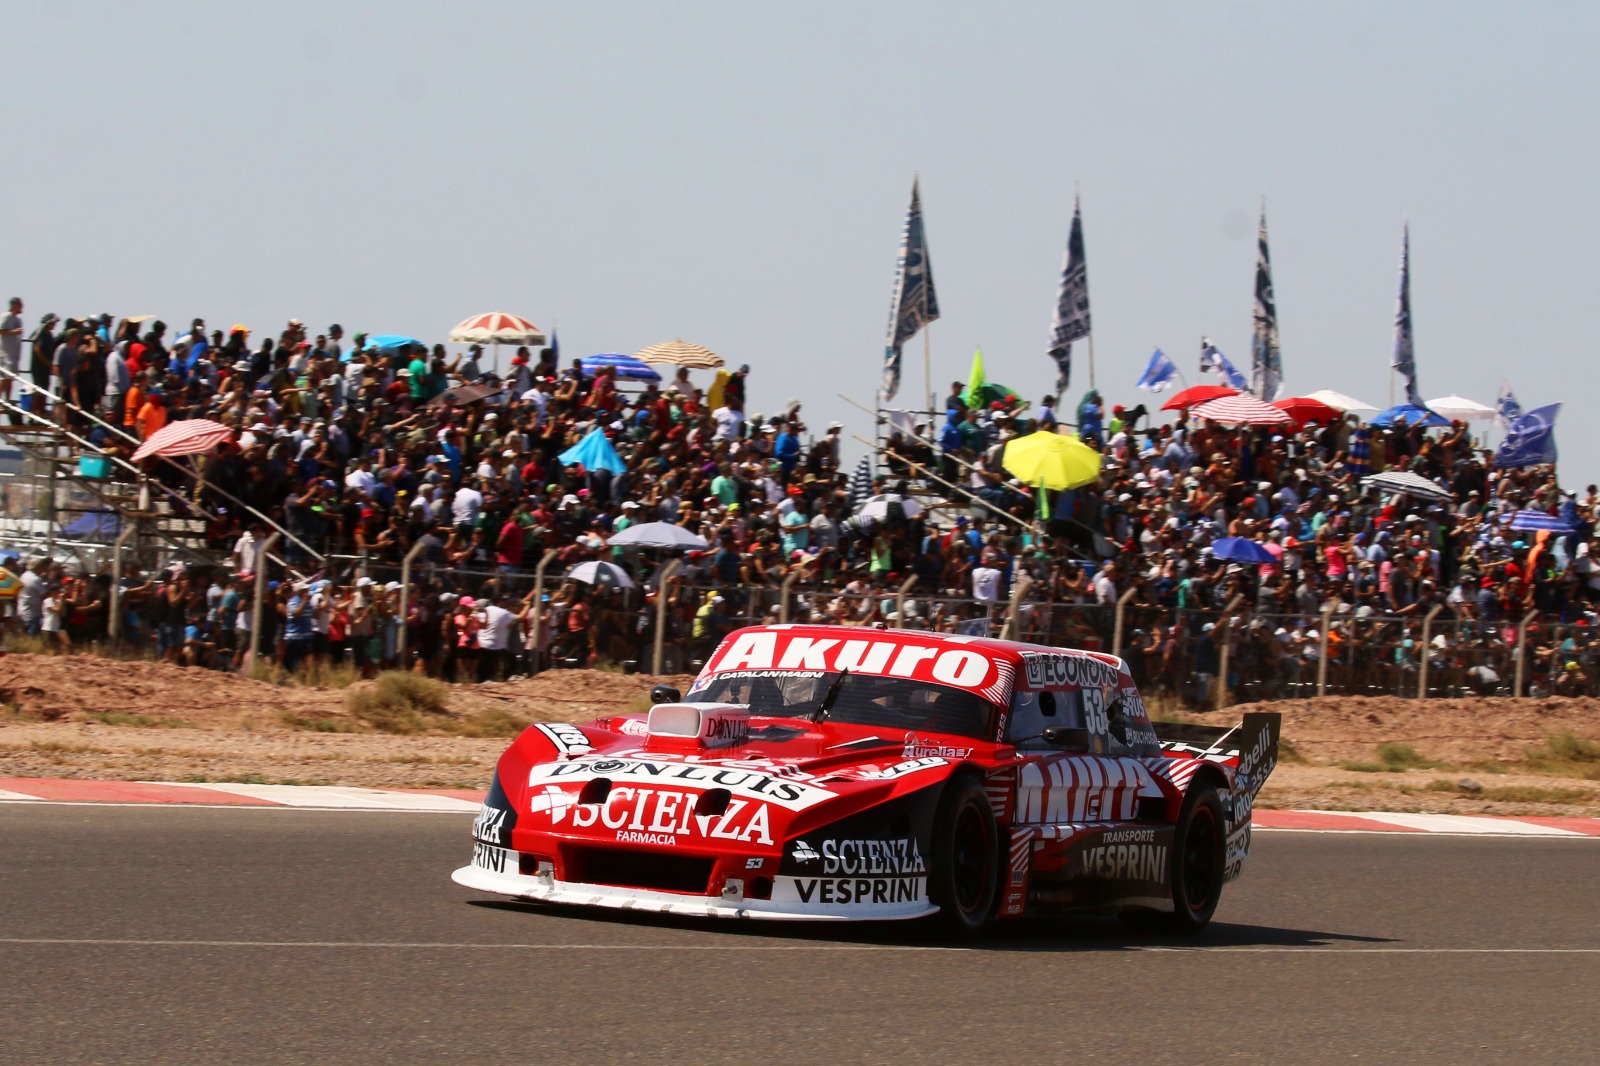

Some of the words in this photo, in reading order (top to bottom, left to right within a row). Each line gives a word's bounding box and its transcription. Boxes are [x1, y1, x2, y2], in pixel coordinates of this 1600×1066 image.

[713, 631, 990, 688] Akuro
[1082, 688, 1106, 735] 53
[670, 766, 807, 801] LUIS
[573, 787, 774, 846] SCIENZA
[616, 830, 676, 846] FARMACIA
[1103, 830, 1155, 844] TRANSPORTE
[745, 857, 764, 870] 53
[822, 838, 926, 875] SCIENZA
[1082, 845, 1167, 884] VESPRINI
[794, 878, 919, 904] VESPRINI
